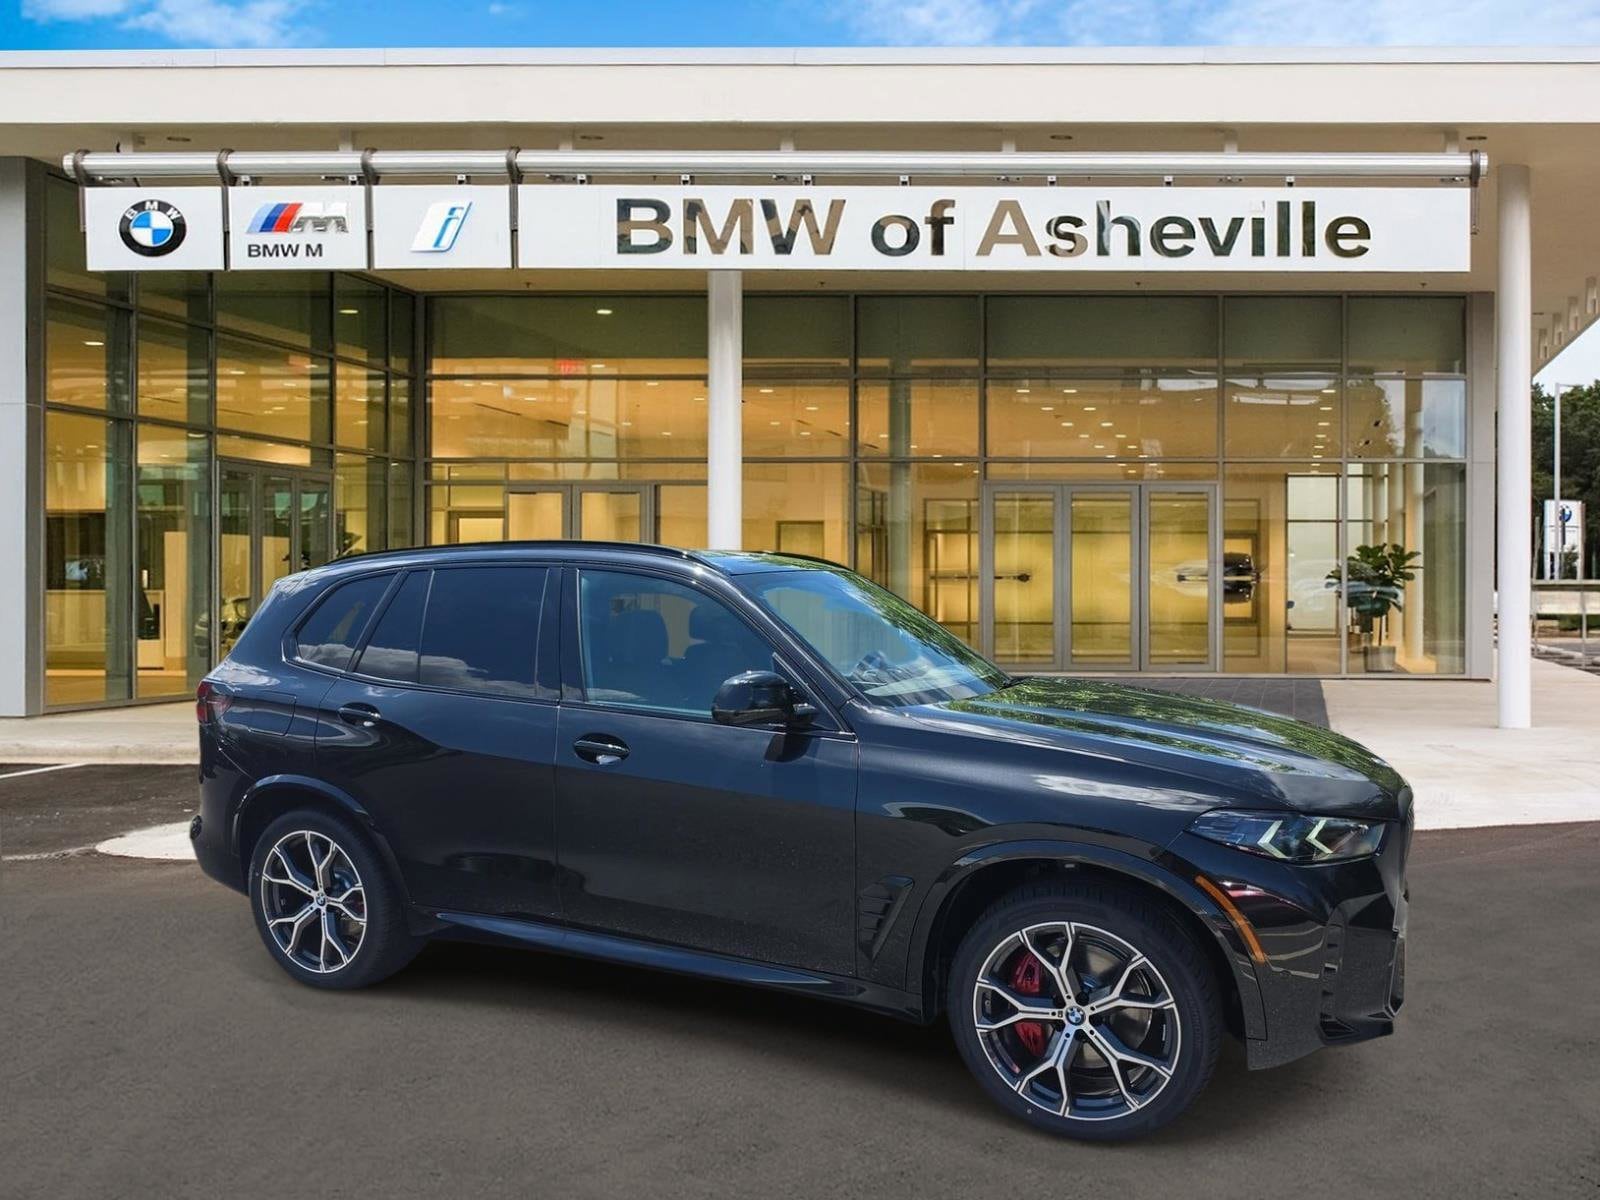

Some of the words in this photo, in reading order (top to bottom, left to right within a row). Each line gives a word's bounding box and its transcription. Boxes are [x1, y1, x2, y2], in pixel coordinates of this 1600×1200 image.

[125, 201, 181, 220] BMW
[616, 198, 846, 255] BMW
[871, 199, 956, 257] of
[975, 200, 1371, 257] Asheville
[247, 244, 299, 258] BMW
[305, 244, 323, 258] M
